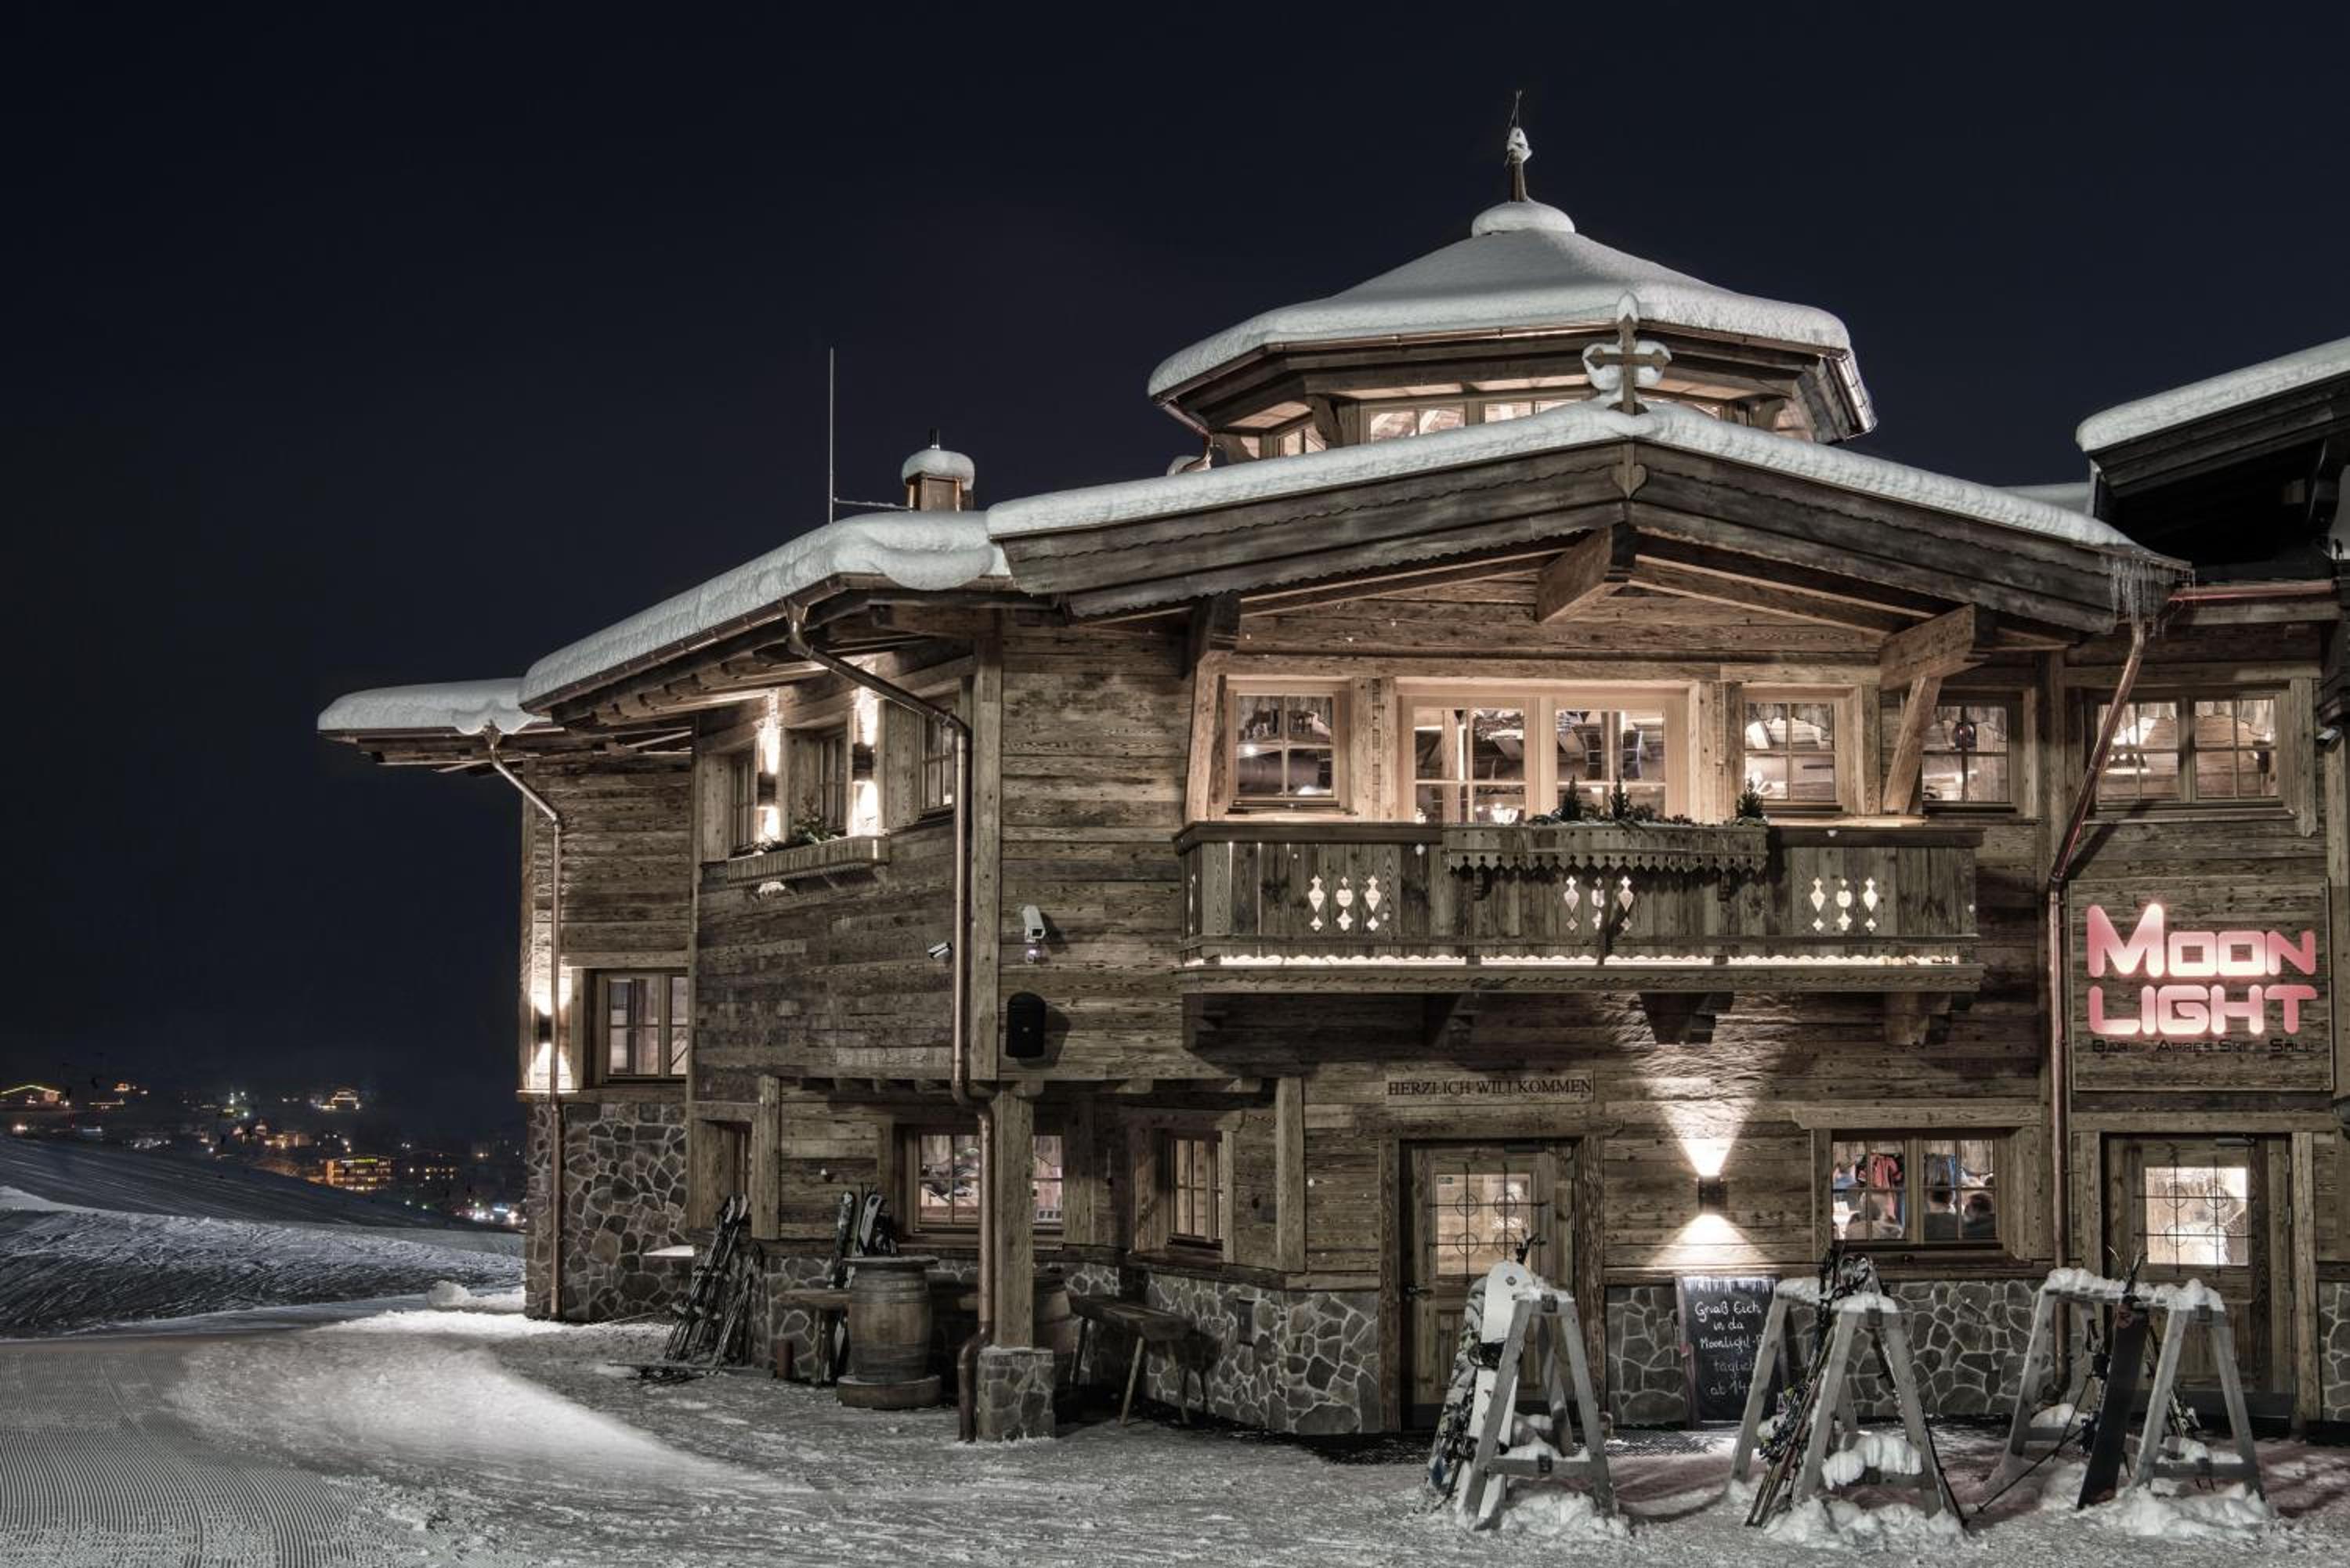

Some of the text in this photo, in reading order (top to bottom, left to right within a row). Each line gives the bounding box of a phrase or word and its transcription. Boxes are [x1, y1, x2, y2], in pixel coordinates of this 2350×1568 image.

[2087, 903, 2316, 978] MOON
[2088, 985, 2318, 1035] LIGHT
[1388, 1078, 1593, 1096] HERZLICH WILLKOMMEN
[1713, 1315, 1745, 1331] in da
